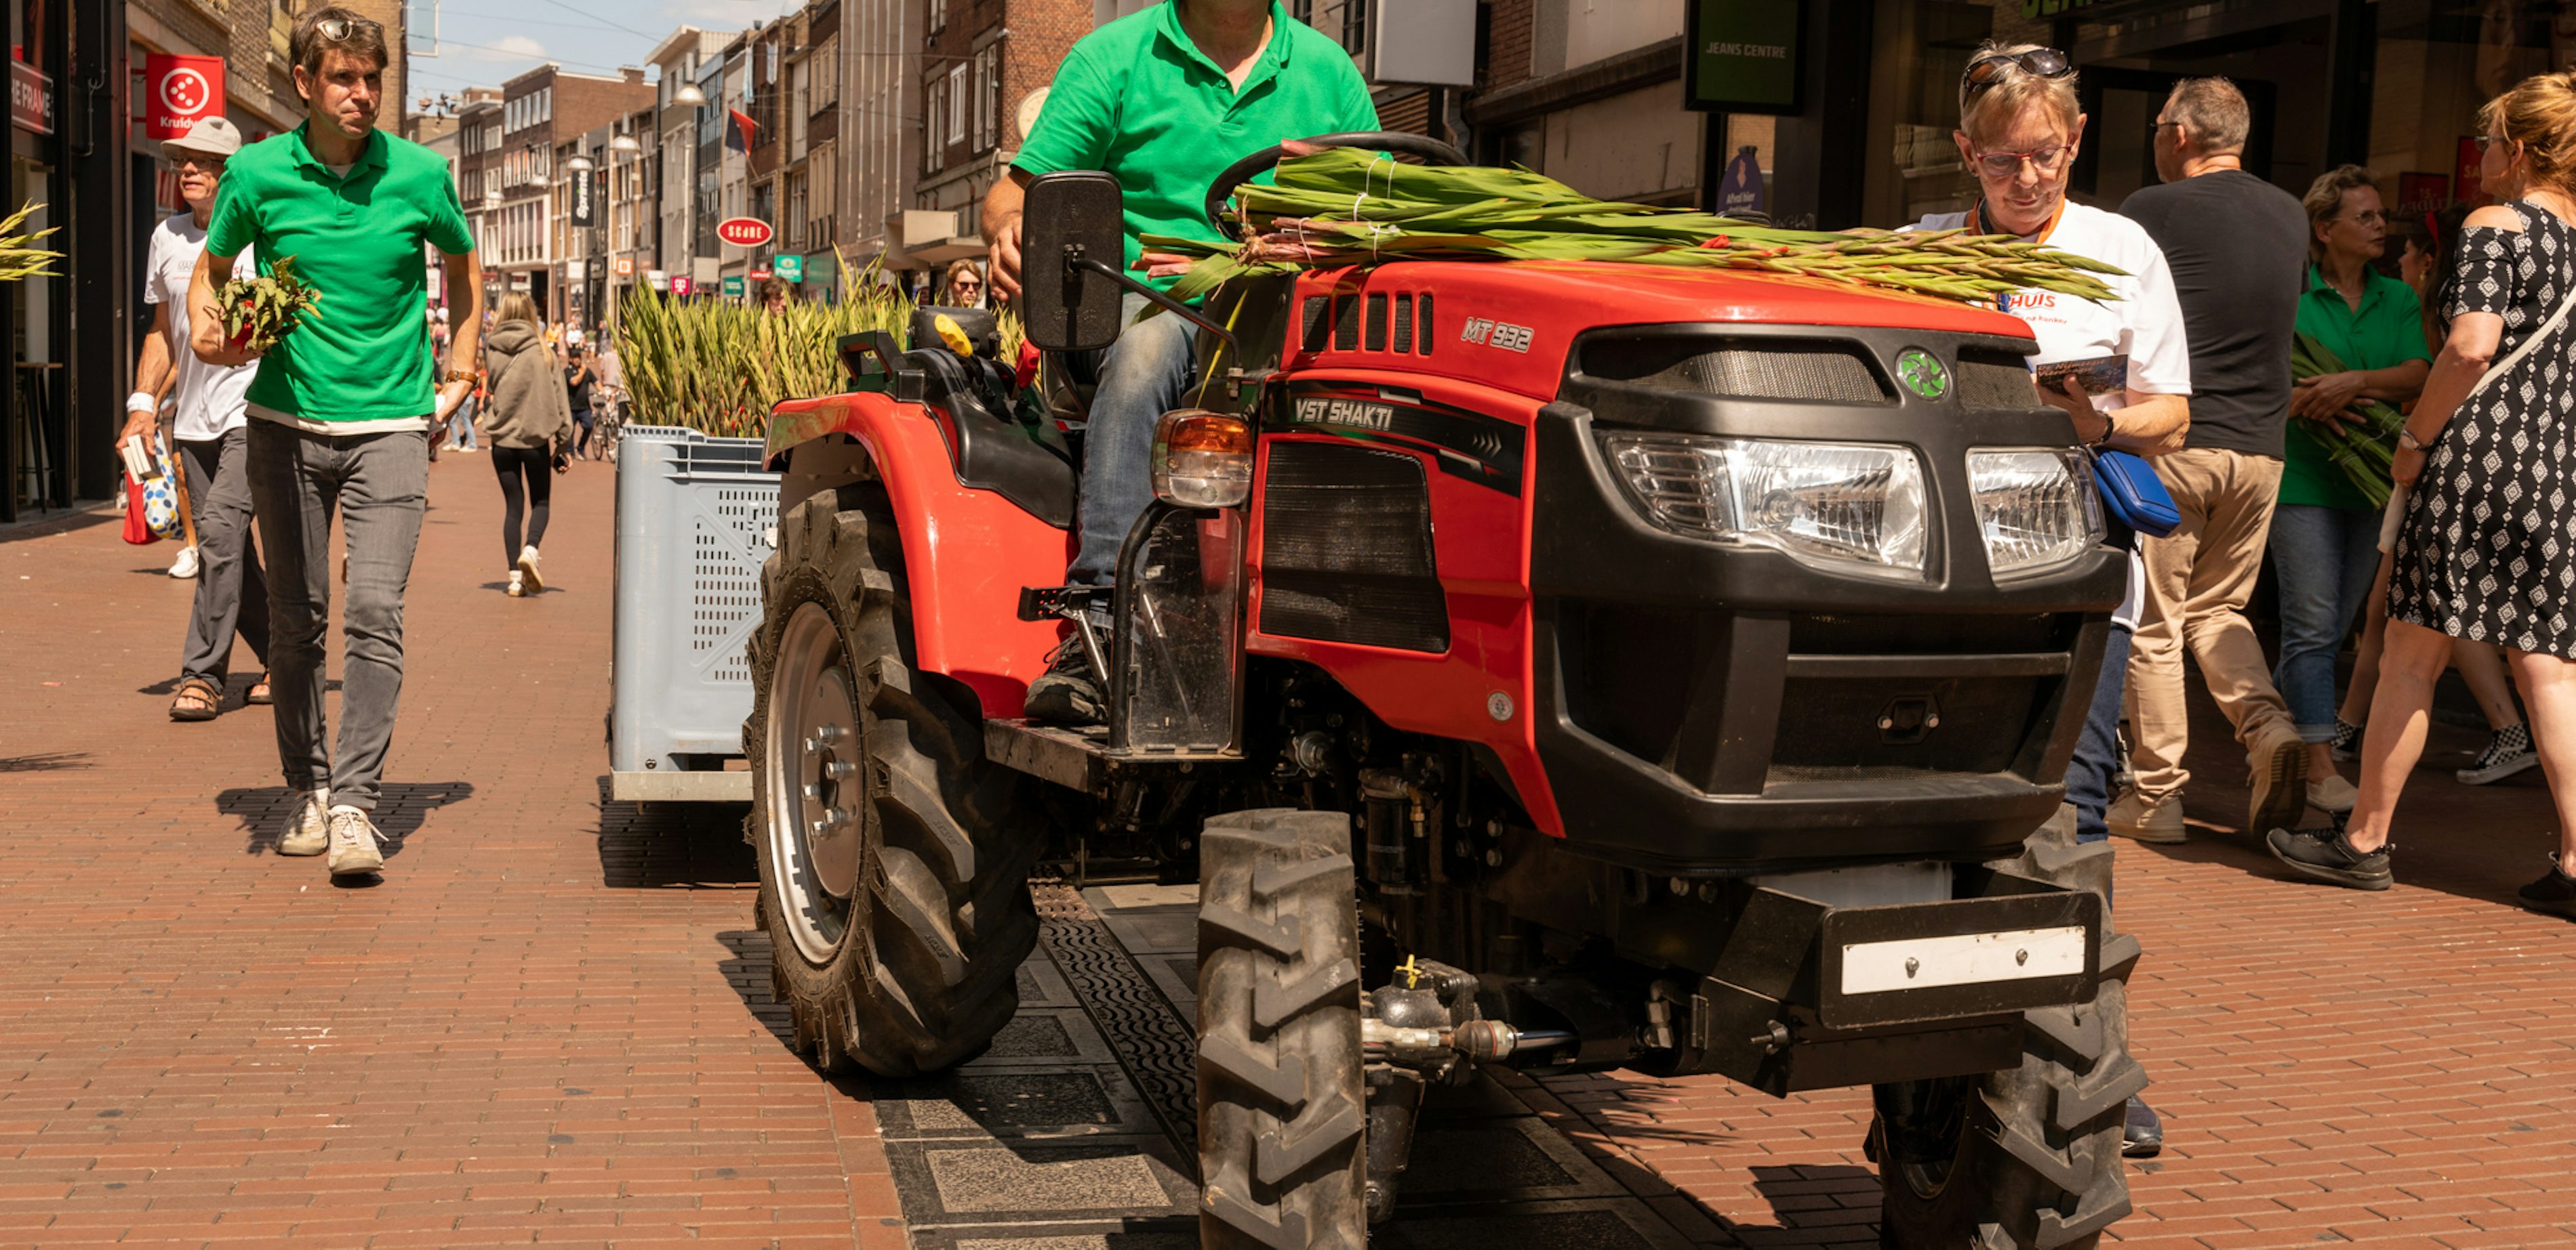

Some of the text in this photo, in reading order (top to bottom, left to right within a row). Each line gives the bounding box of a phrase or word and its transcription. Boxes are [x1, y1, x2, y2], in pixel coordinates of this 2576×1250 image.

[1706, 41, 1787, 59] JEANS CENTRE
[22, 82, 51, 118] FRAME
[2463, 165, 2480, 178] SA
[576, 171, 590, 220] Sprinte
[1461, 317, 1535, 353] MT 932
[2038, 315, 2068, 325] kanker
[1295, 398, 1394, 430] VST SHAKTI
